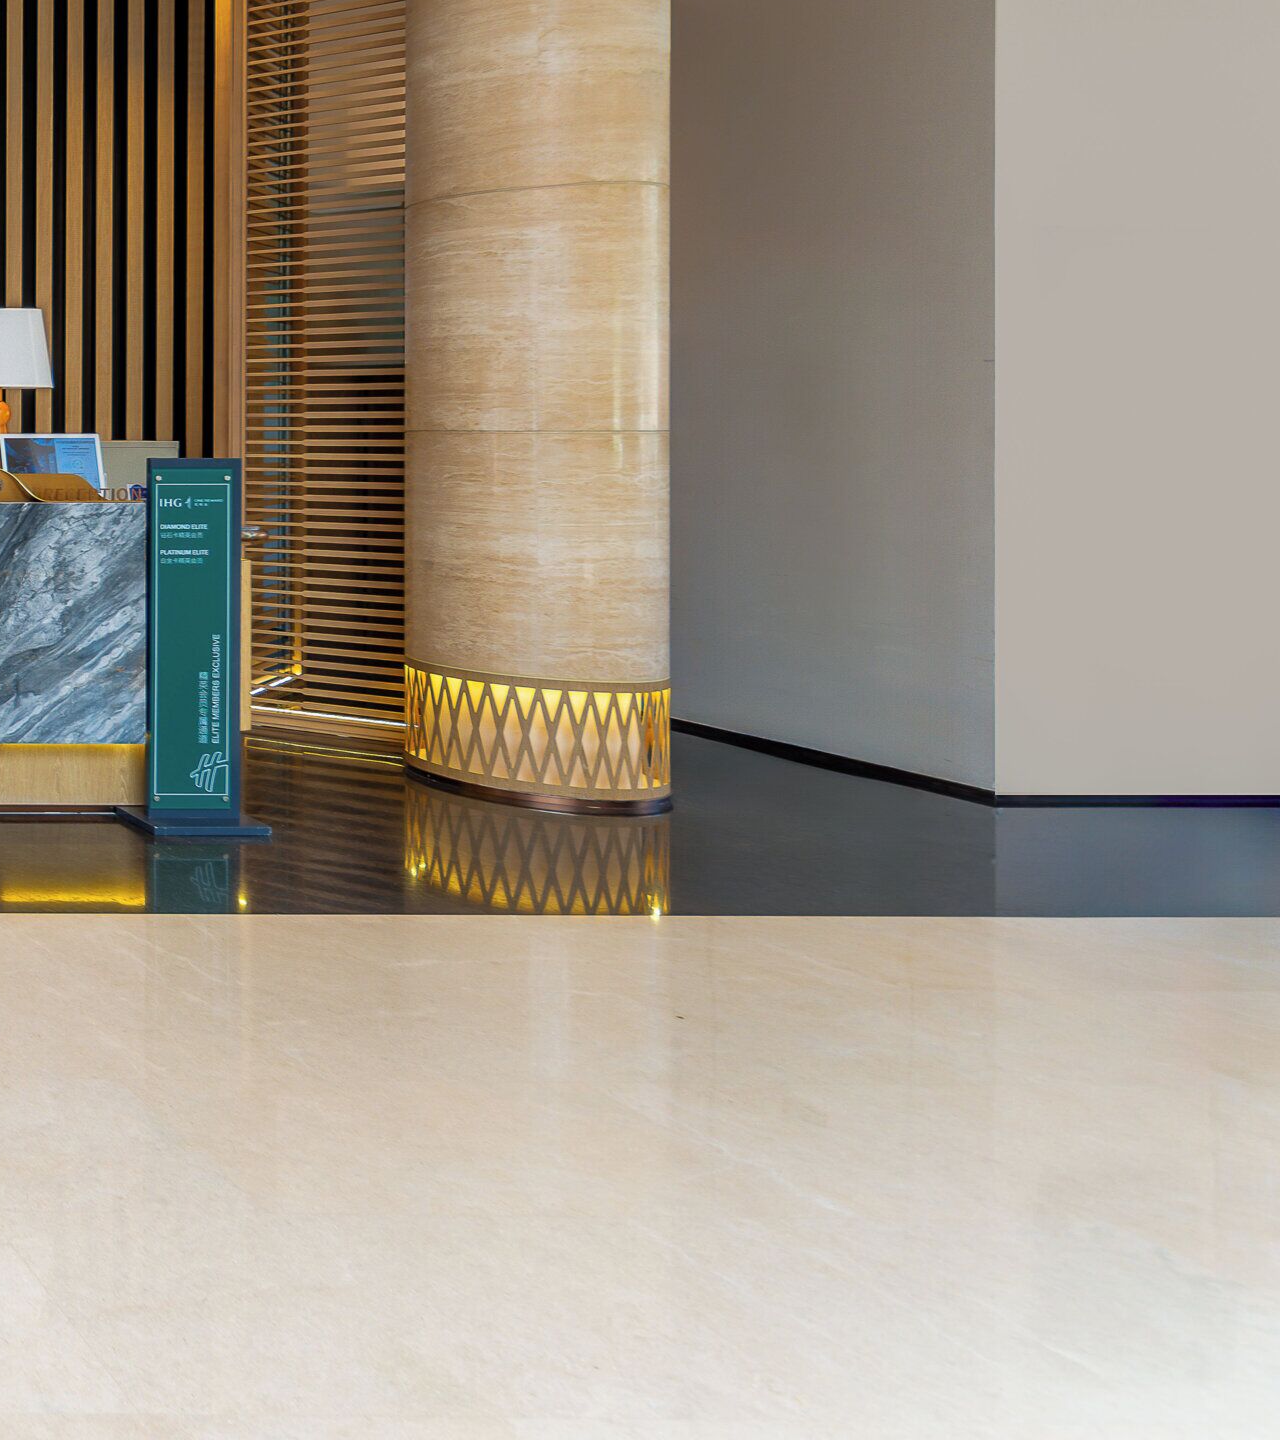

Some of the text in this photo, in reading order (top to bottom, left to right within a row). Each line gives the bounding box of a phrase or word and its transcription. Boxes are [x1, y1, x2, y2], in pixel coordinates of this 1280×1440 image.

[159, 498, 182, 508] IHG
[211, 634, 220, 744] ELITE MEMBERS EXCLUSIVE
